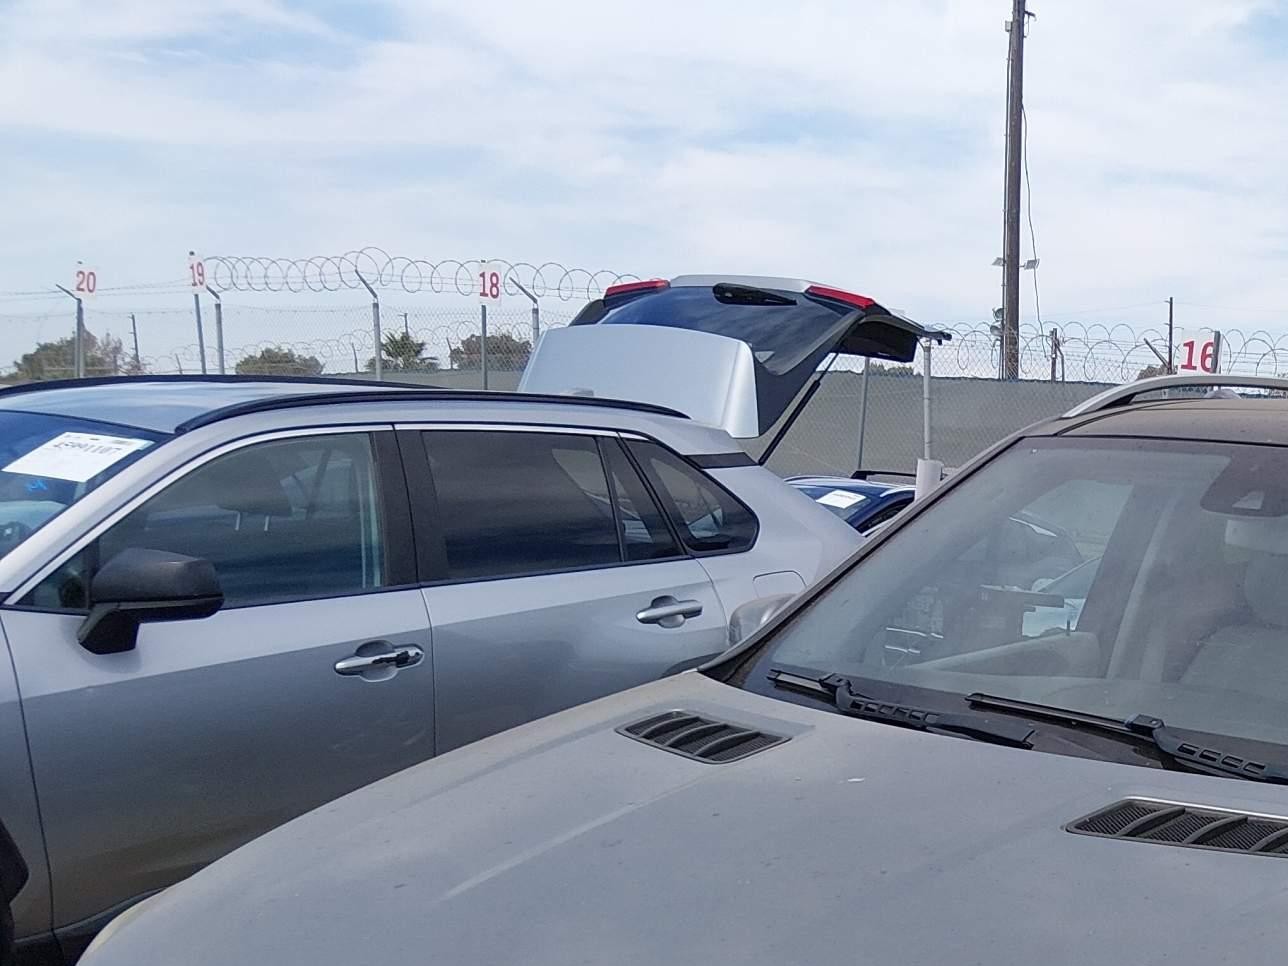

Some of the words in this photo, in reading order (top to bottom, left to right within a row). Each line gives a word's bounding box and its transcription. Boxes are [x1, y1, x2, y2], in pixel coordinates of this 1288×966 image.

[76, 270, 97, 293] 20
[189, 261, 205, 287] 19
[479, 271, 500, 299] 18
[1180, 340, 1217, 374] 16
